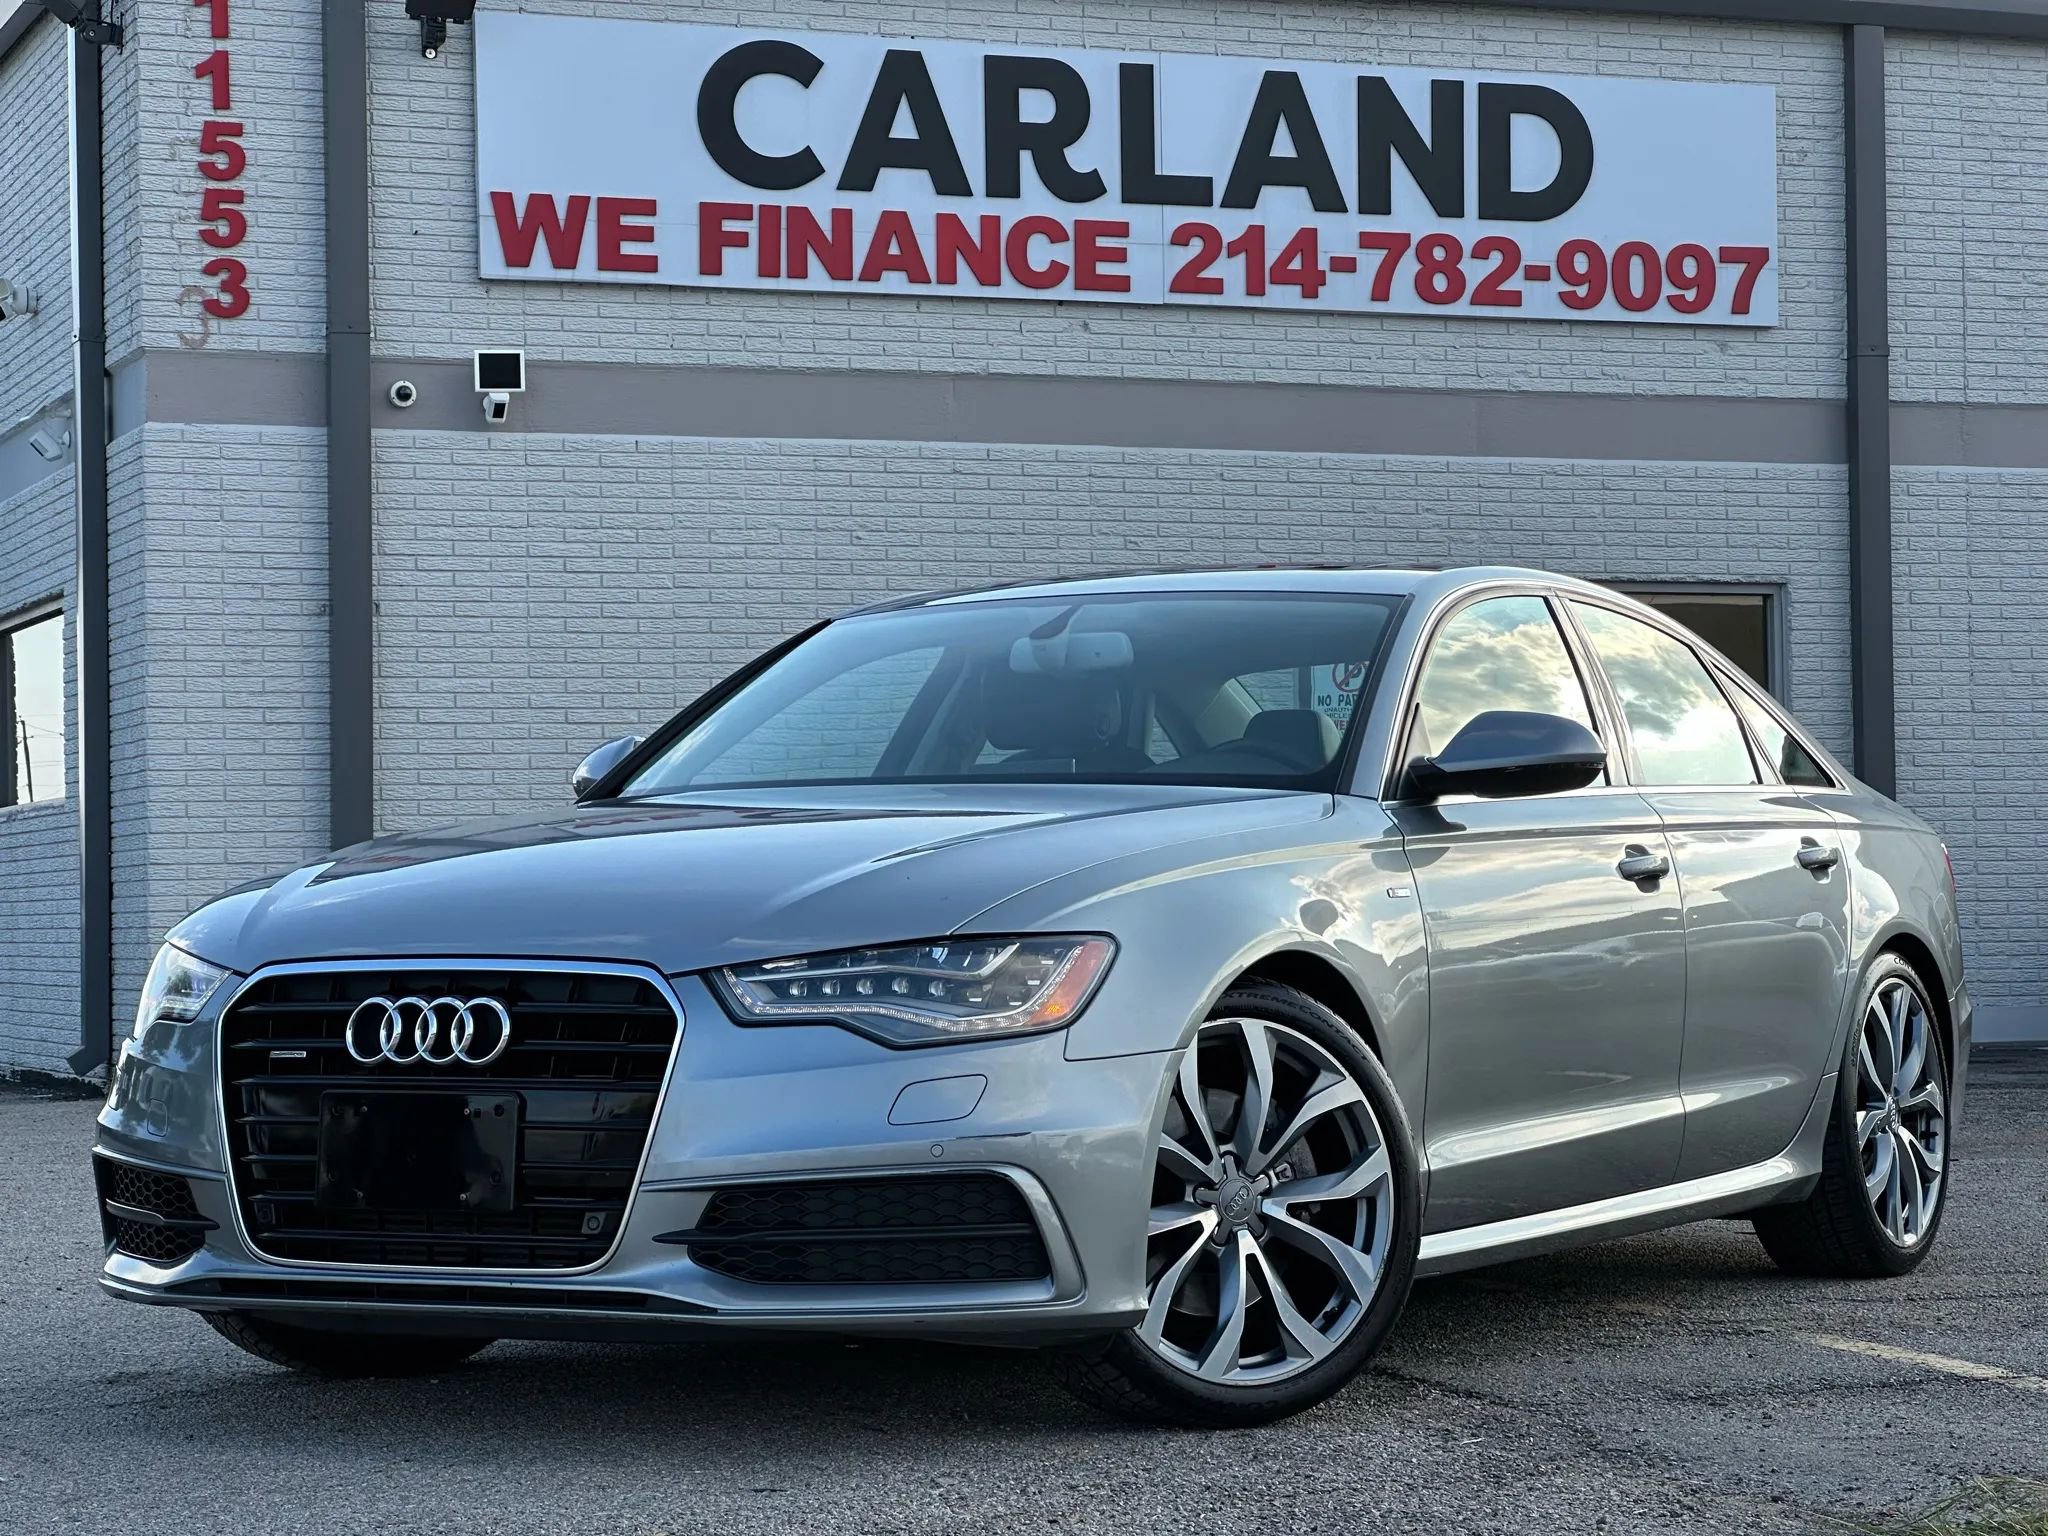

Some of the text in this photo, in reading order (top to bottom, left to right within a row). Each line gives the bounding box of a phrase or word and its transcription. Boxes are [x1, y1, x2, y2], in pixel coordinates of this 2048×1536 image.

[697, 39, 1594, 222] CARLAND
[489, 190, 1770, 315] WE FINANCE 214-782-9097
[1317, 694, 1332, 707] NO
[1220, 991, 1370, 1062] XTREMECONTACT
